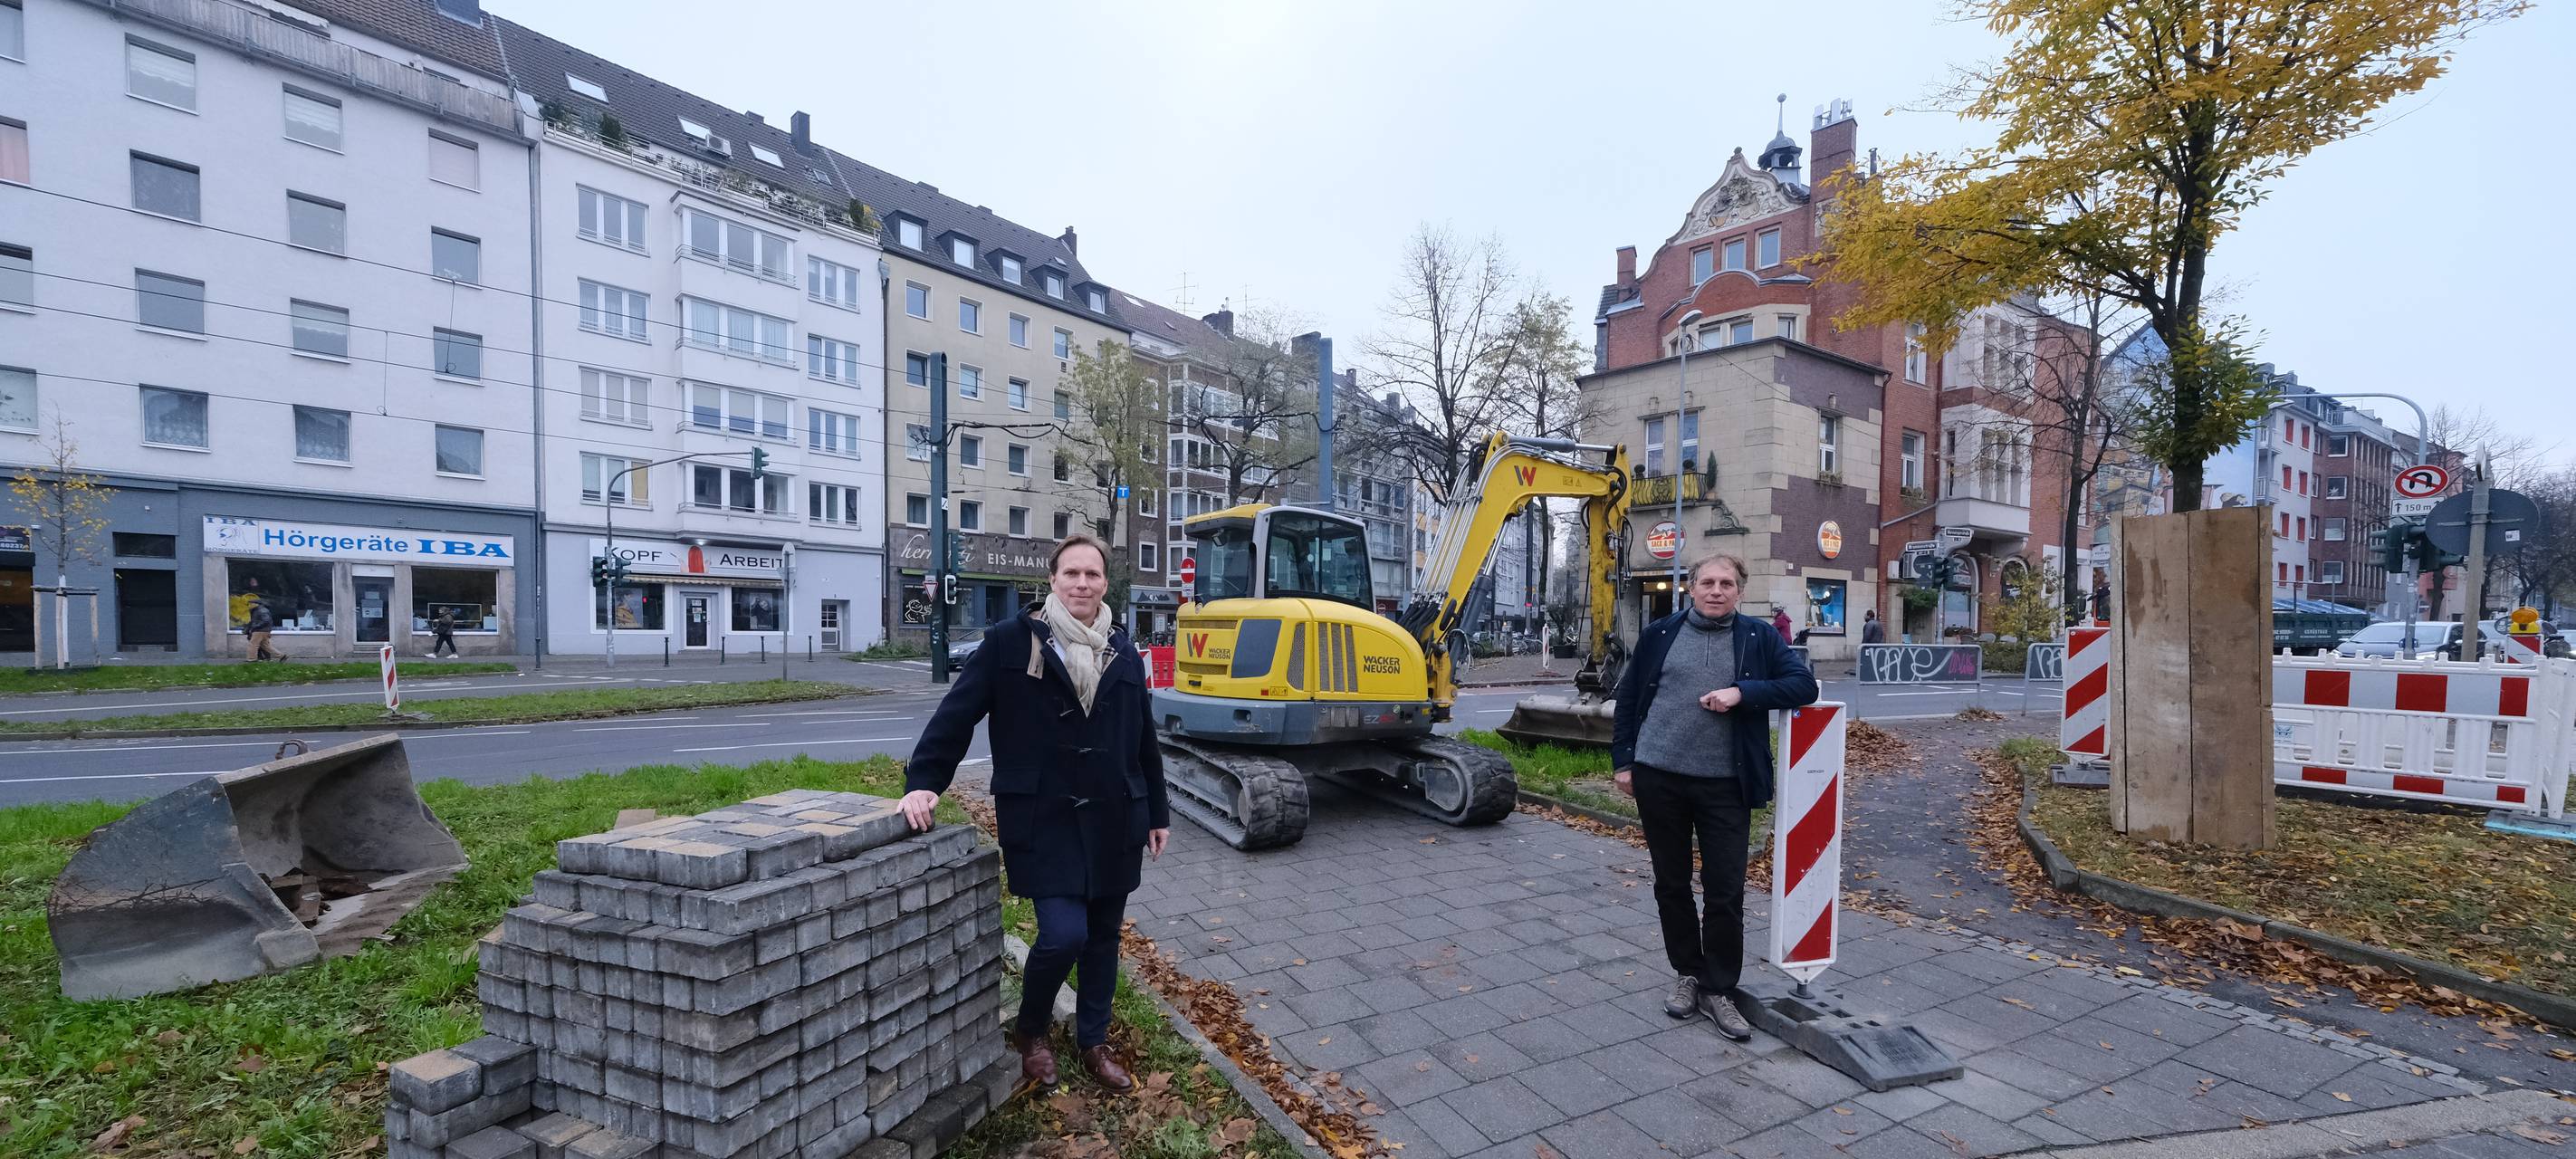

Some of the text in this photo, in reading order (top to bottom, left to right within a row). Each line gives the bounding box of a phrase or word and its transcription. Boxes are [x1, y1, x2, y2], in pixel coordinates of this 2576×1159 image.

[264, 529, 511, 558] Hörgeräte IBA
[720, 553, 783, 569] ARBEIT
[1363, 655, 1401, 666] WACKER
[1363, 664, 1401, 675] NEUSON
